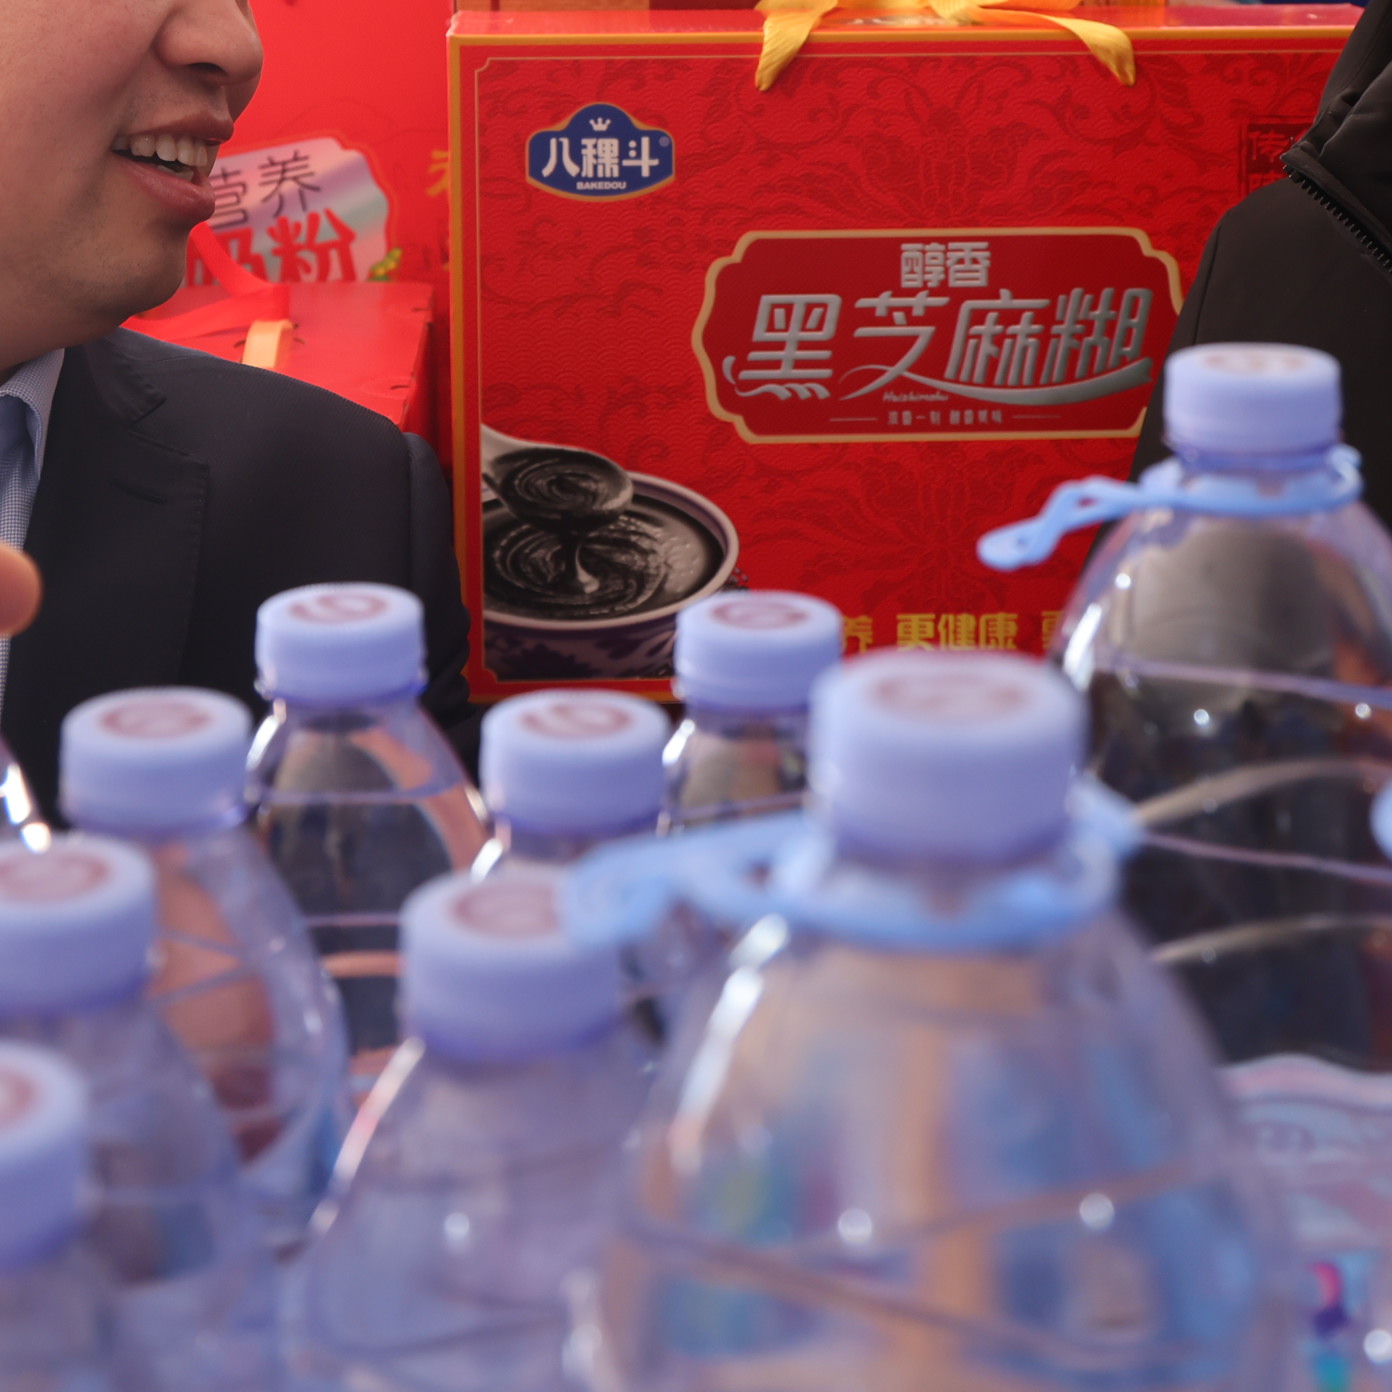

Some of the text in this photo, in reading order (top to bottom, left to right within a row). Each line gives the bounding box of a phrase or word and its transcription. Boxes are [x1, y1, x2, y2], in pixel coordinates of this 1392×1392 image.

[541, 136, 659, 178] 八稞斗
[576, 181, 626, 190] BAKEDOU
[900, 241, 990, 288] 醇香
[723, 287, 1153, 405] 黑芝麻糊
[896, 612, 1018, 652] 更健康
